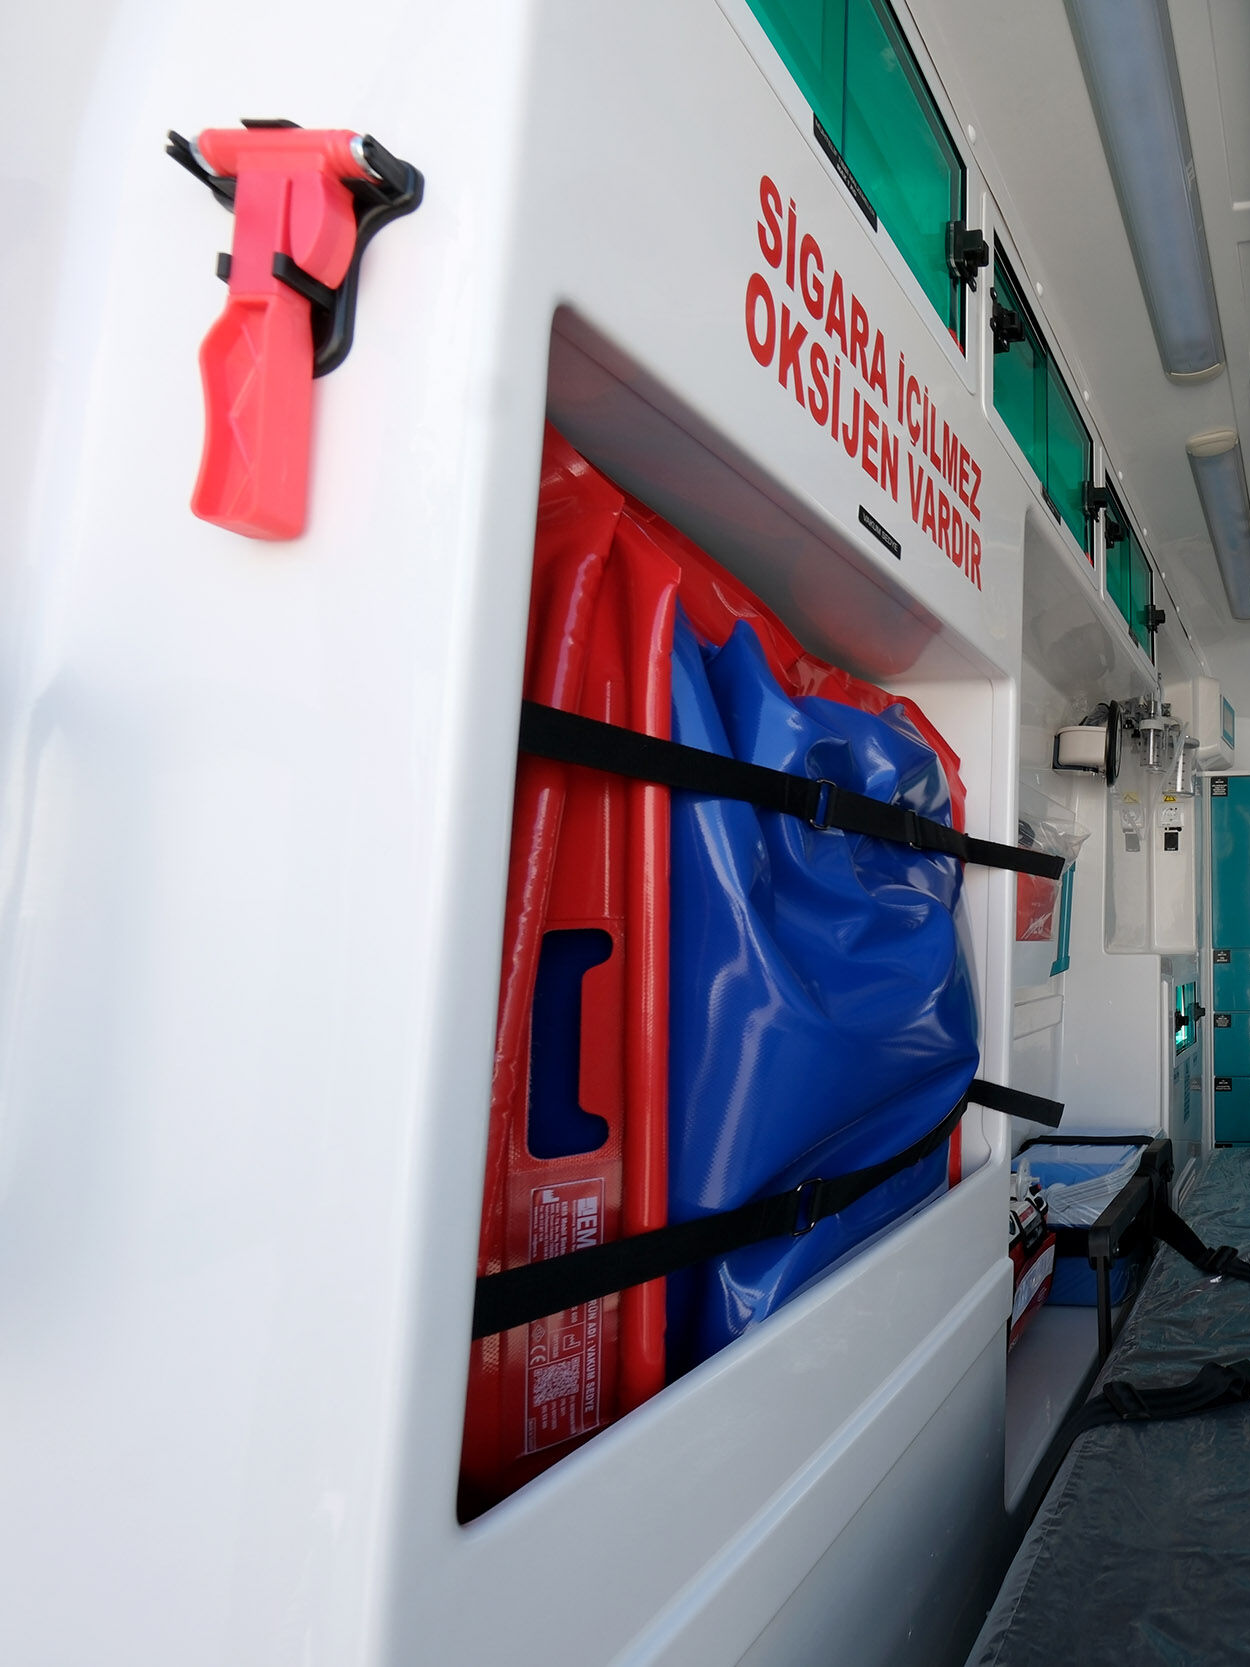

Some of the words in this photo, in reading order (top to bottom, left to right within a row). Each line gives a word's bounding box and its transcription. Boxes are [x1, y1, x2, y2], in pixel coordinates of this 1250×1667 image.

[757, 176, 888, 406] SİGARA
[898, 352, 982, 520] İÇİLMEZ
[746, 273, 898, 502] OKSİJEN
[908, 453, 982, 591] VARDIR
[862, 512, 882, 536] VAKUM
[881, 530, 898, 552] SEDYE
[576, 1215, 598, 1249] EM
[588, 1300, 598, 1320] RÜN
[587, 1322, 597, 1339] ADI
[586, 1345, 597, 1381] VAKUM
[585, 1383, 596, 1413] SEDYE
